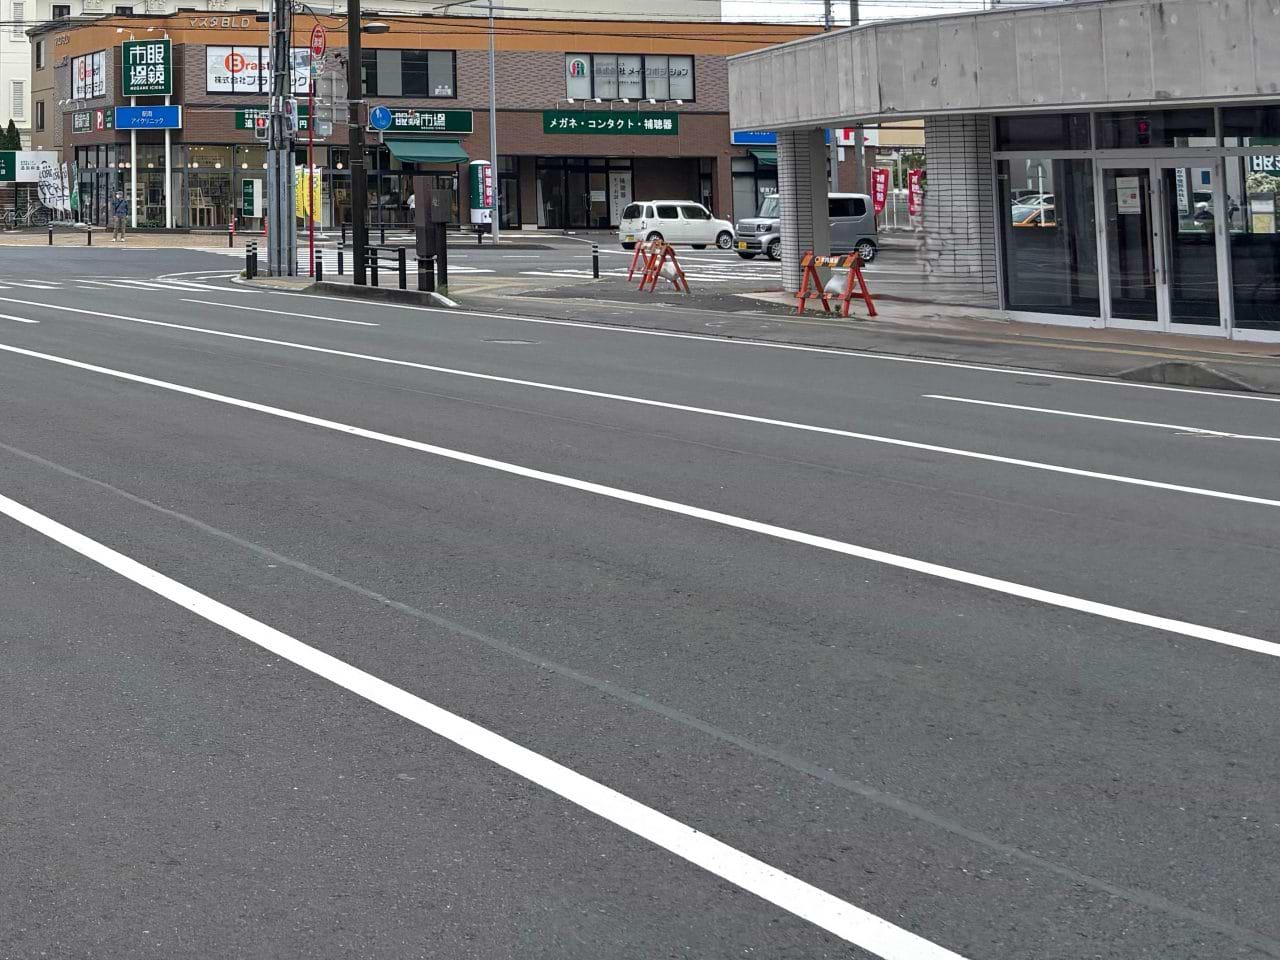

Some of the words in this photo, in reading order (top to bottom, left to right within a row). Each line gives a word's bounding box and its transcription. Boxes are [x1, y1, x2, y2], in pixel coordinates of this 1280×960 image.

[549, 117, 673, 131] メガネ・コンタクト・補聴器
